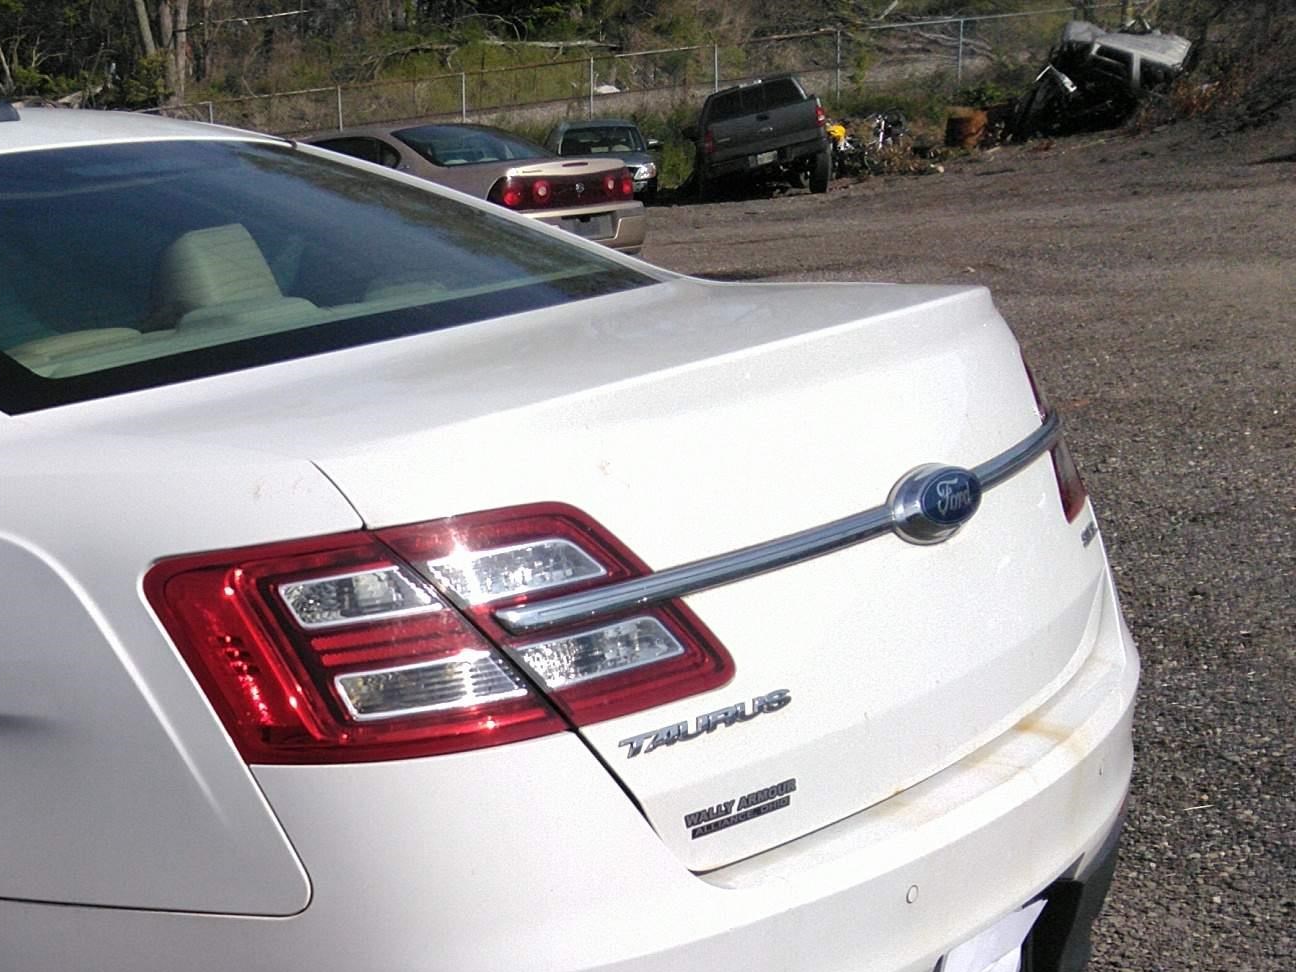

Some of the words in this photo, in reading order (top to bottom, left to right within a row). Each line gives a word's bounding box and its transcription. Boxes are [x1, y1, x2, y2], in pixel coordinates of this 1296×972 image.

[936, 478, 972, 516] Ford
[618, 689, 792, 759] TAURUS
[684, 799, 736, 829] WALLY
[737, 778, 797, 812] ARMOUR
[760, 795, 790, 815] OHIO
